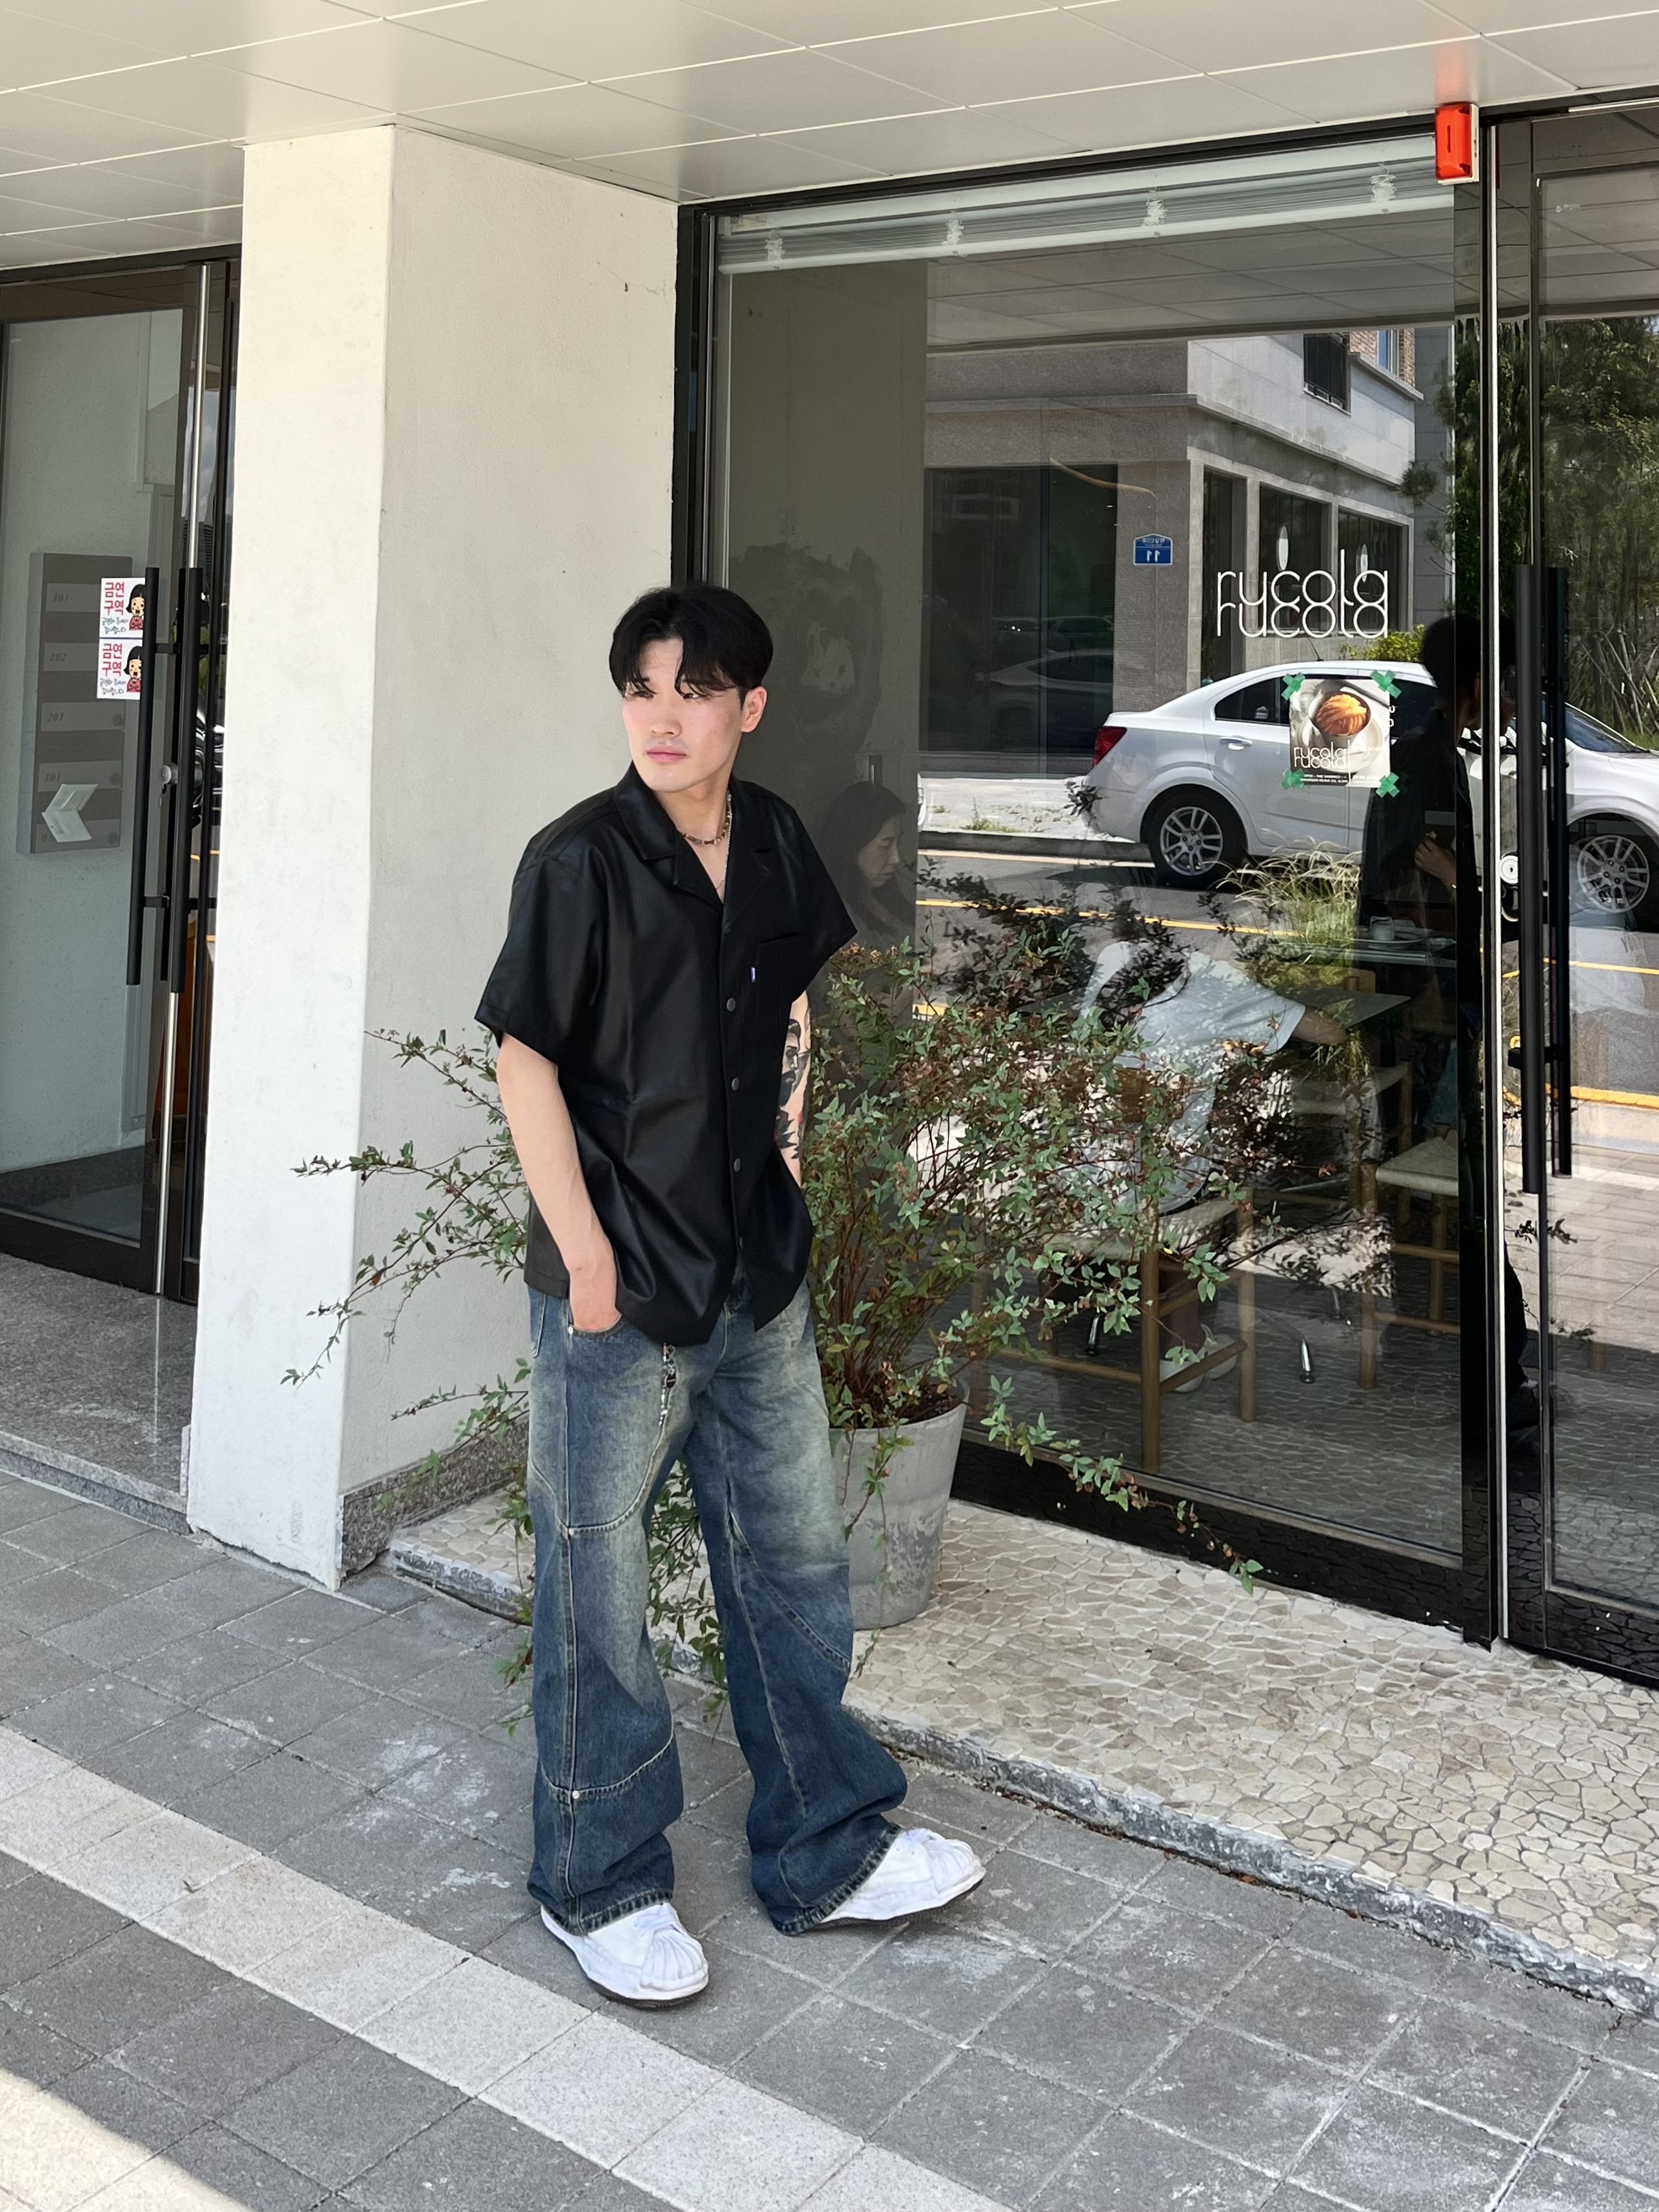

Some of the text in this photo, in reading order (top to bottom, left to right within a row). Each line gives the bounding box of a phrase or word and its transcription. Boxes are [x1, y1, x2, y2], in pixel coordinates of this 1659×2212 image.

[104, 582, 124, 598] 금연
[52, 593, 68, 603] 301
[104, 600, 124, 615] 구역
[50, 652, 67, 662] 202
[103, 643, 123, 659] 금연
[102, 661, 122, 677] 구역
[47, 712, 64, 722] 201
[45, 772, 61, 782] 101
